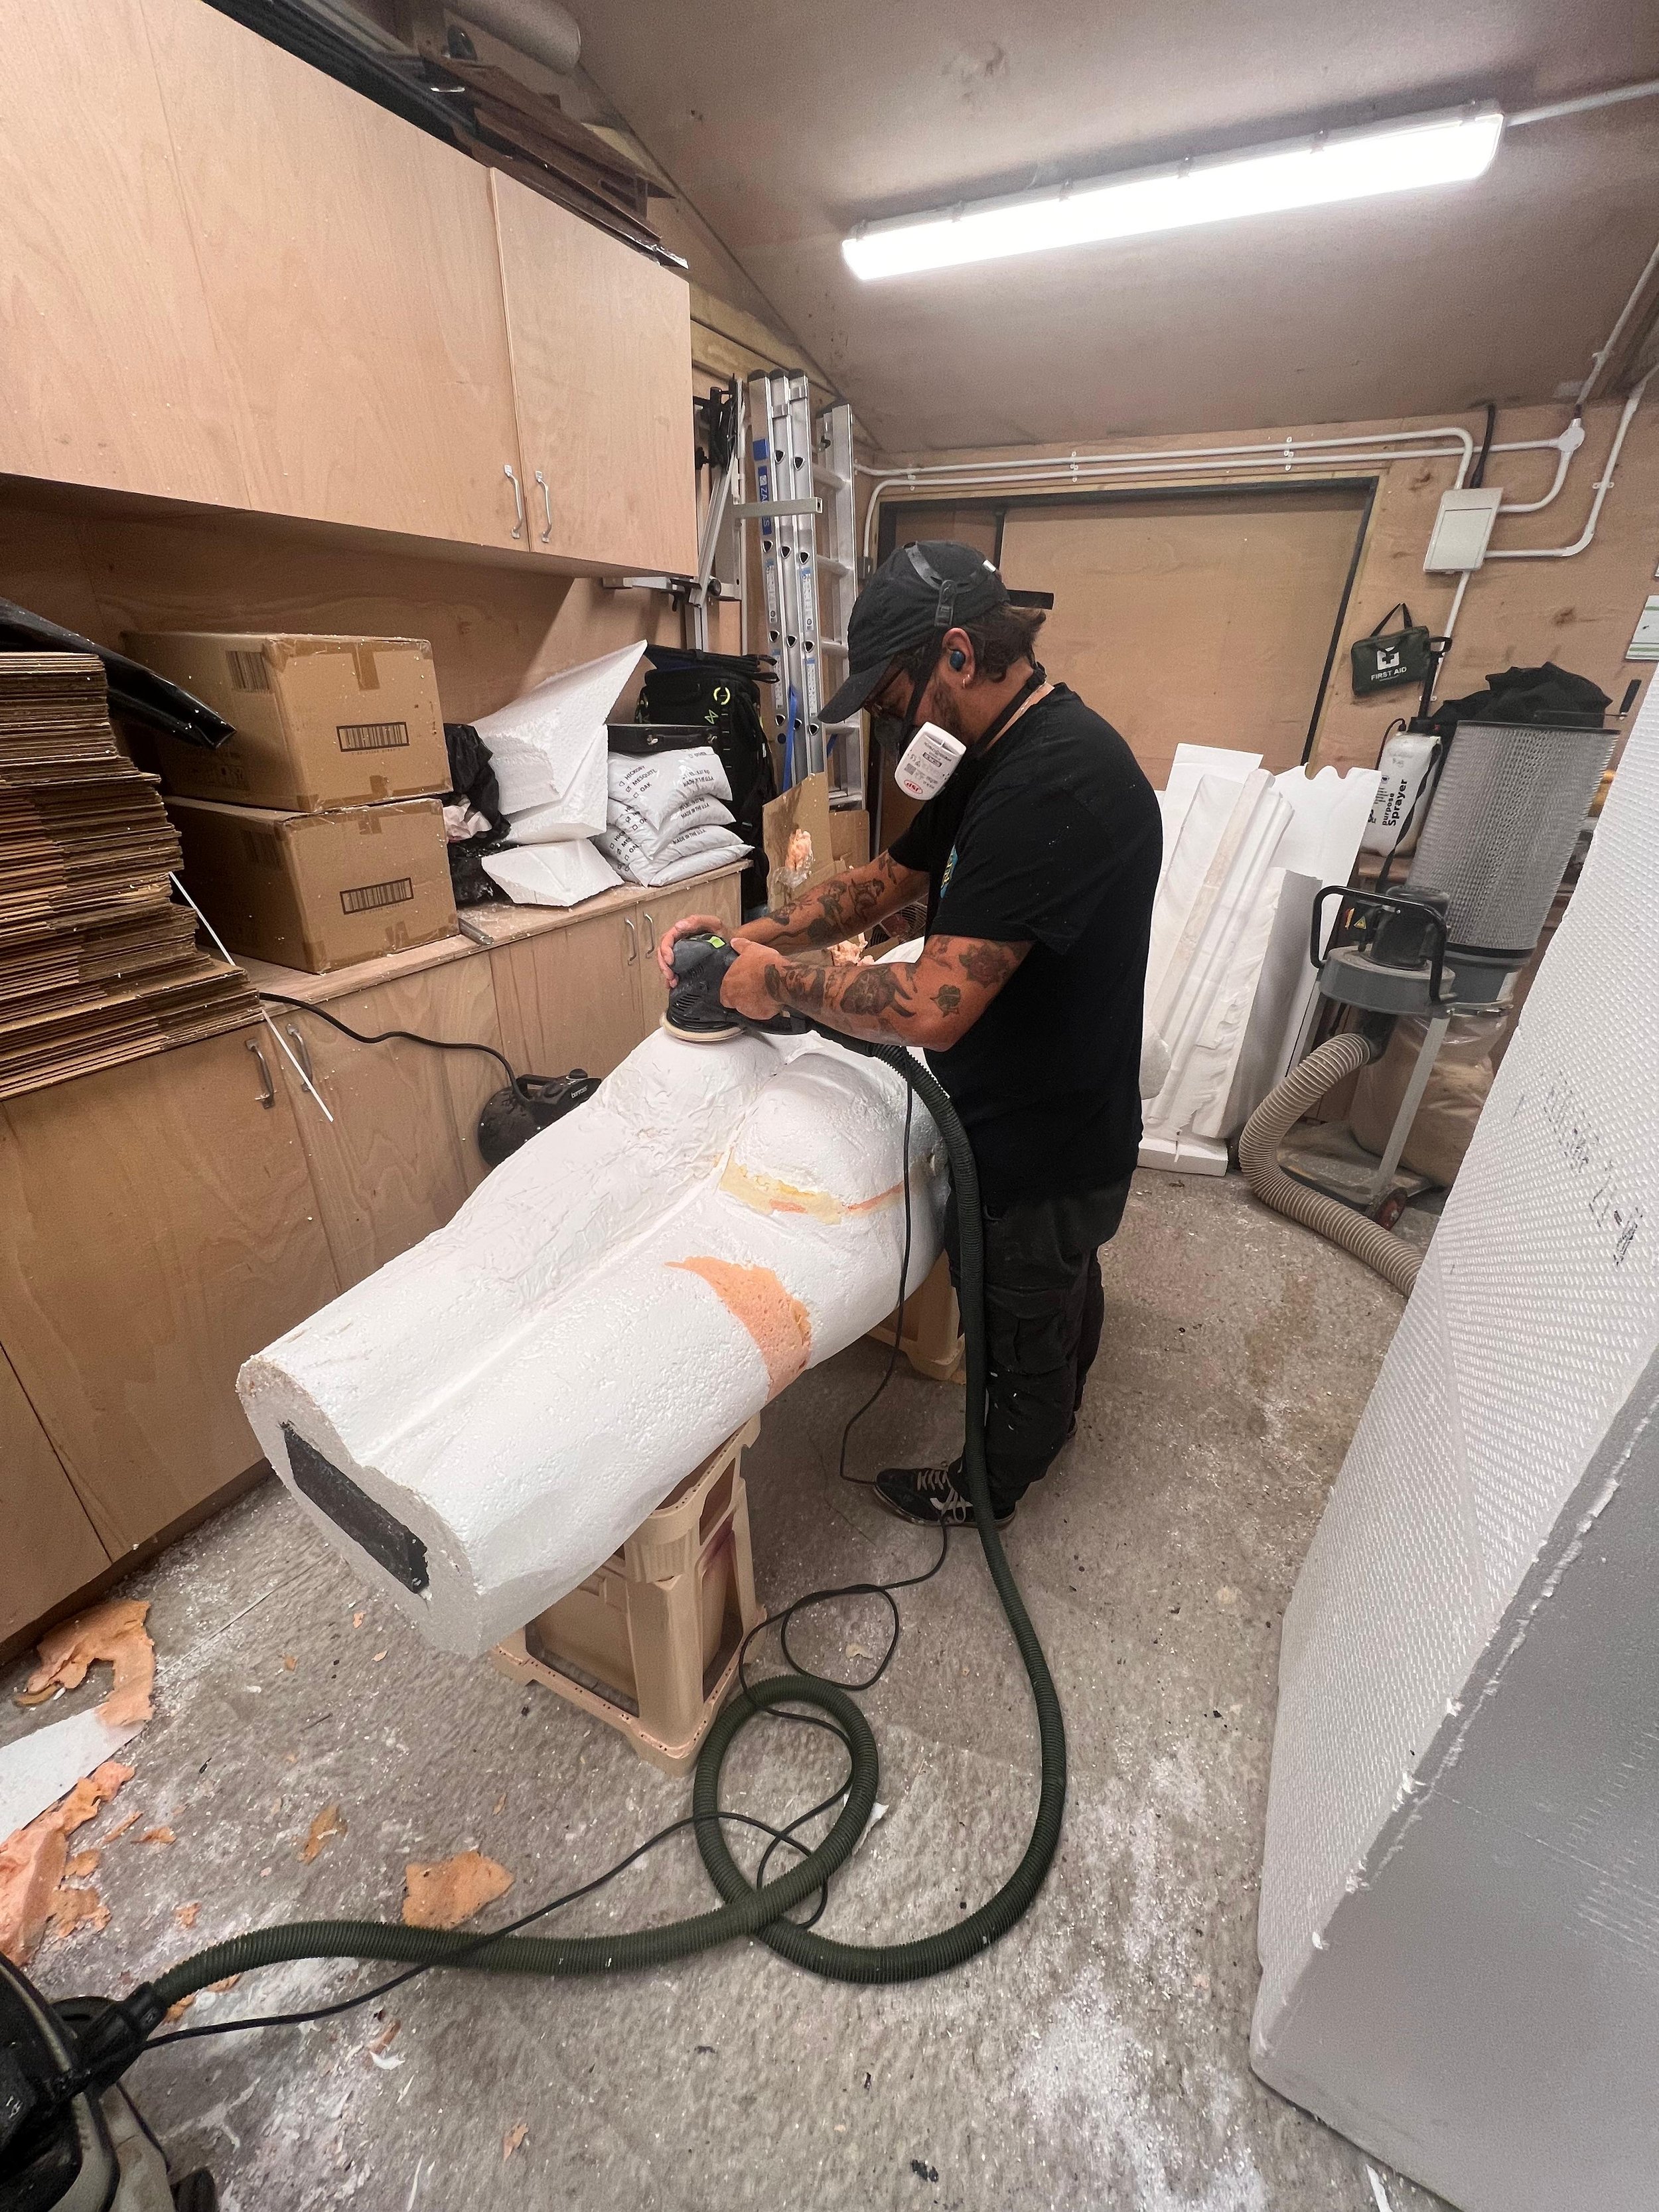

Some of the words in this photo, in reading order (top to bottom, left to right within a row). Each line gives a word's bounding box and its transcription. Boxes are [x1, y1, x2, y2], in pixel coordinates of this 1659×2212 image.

[1370, 670, 1393, 681] FIRST
[1394, 666, 1407, 675] AID
[624, 765, 646, 780] HICKORY
[640, 782, 652, 792] OAK
[1382, 793, 1395, 826] purpose
[1388, 778, 1407, 826] Sprayer
[672, 836, 685, 844] MADE
